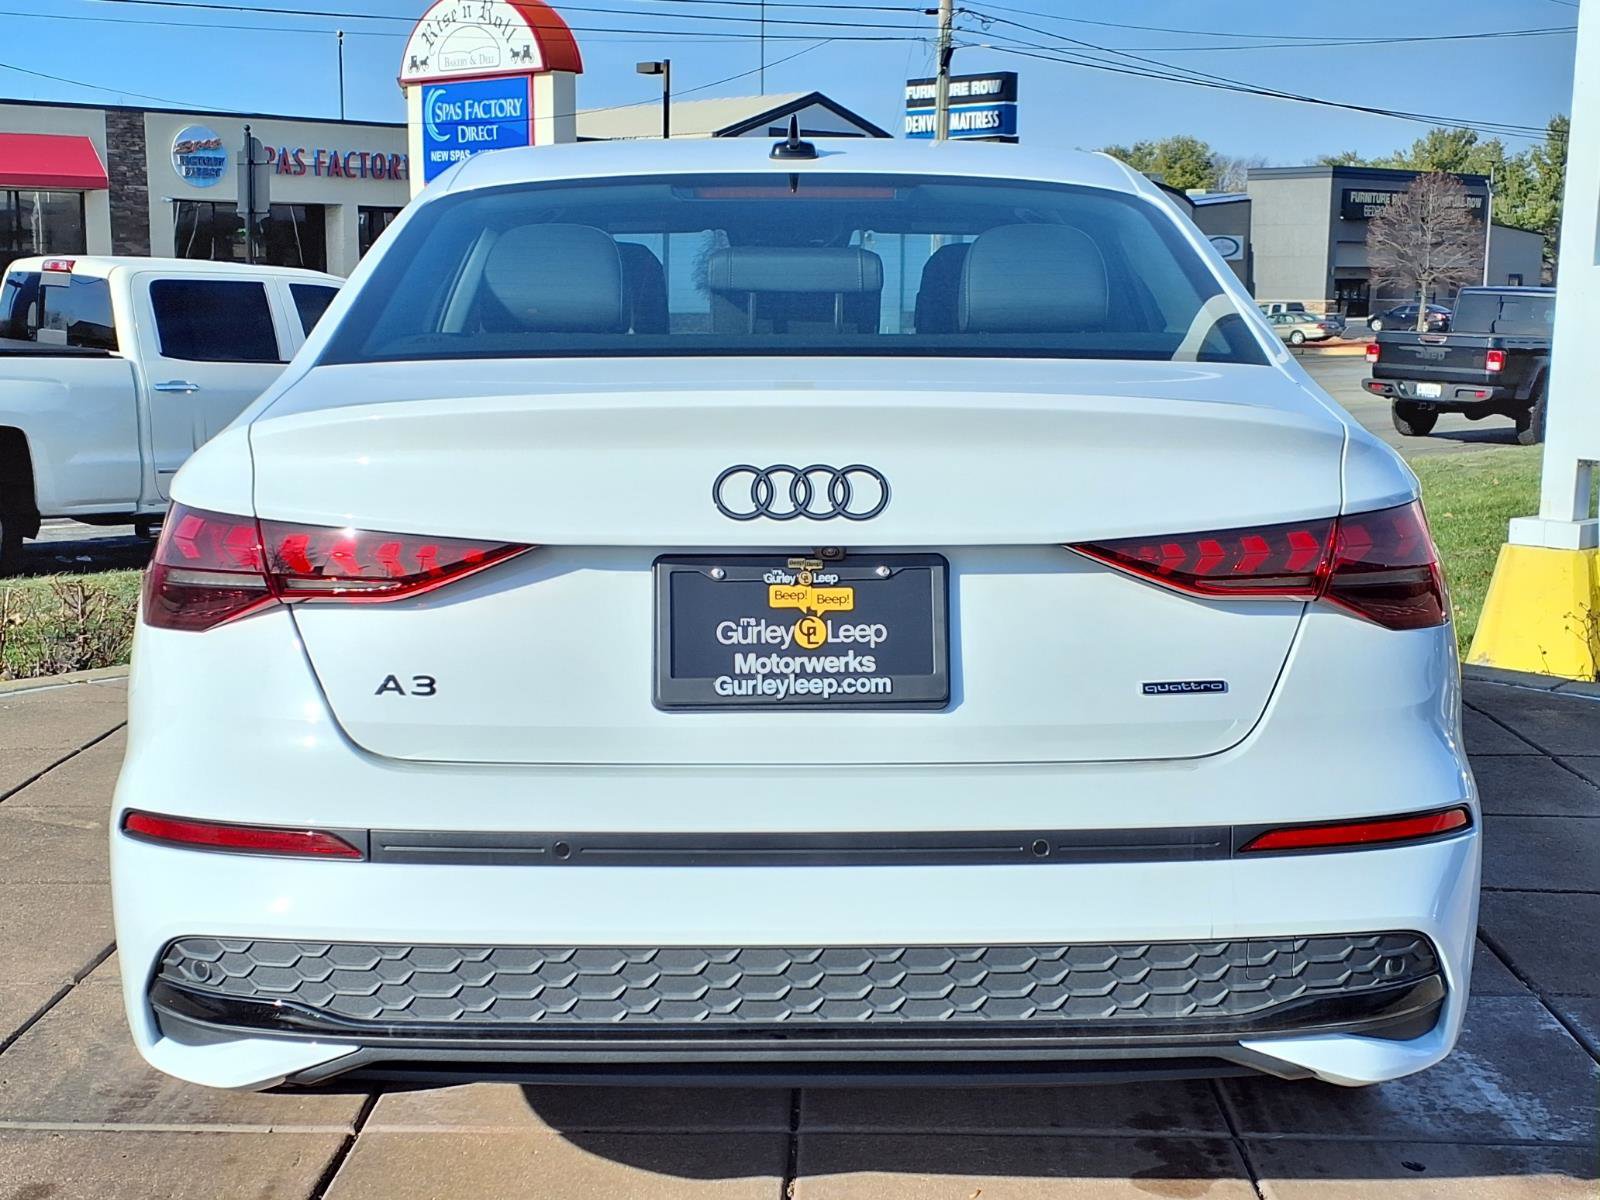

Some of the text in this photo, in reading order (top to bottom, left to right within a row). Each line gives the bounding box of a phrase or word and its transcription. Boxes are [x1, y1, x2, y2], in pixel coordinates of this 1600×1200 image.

[479, 0, 517, 44] Roll
[905, 79, 1003, 100] FURNRE ROW
[434, 98, 523, 123] SPAS FACTORY
[904, 110, 999, 133] DENV MATTRESS
[457, 125, 499, 143] DIRECT
[264, 146, 307, 176] PAS
[430, 150, 449, 161] NEW
[763, 572, 796, 586] Gurley
[813, 572, 839, 585] Leep
[774, 590, 850, 606] Beep! Beep!
[716, 619, 795, 649] Gurley
[827, 619, 887, 648] Leep
[734, 650, 876, 674] Motorwerks
[374, 674, 437, 697] A3
[714, 674, 892, 699] Gurleyleep.com
[1144, 682, 1223, 694] quattro
